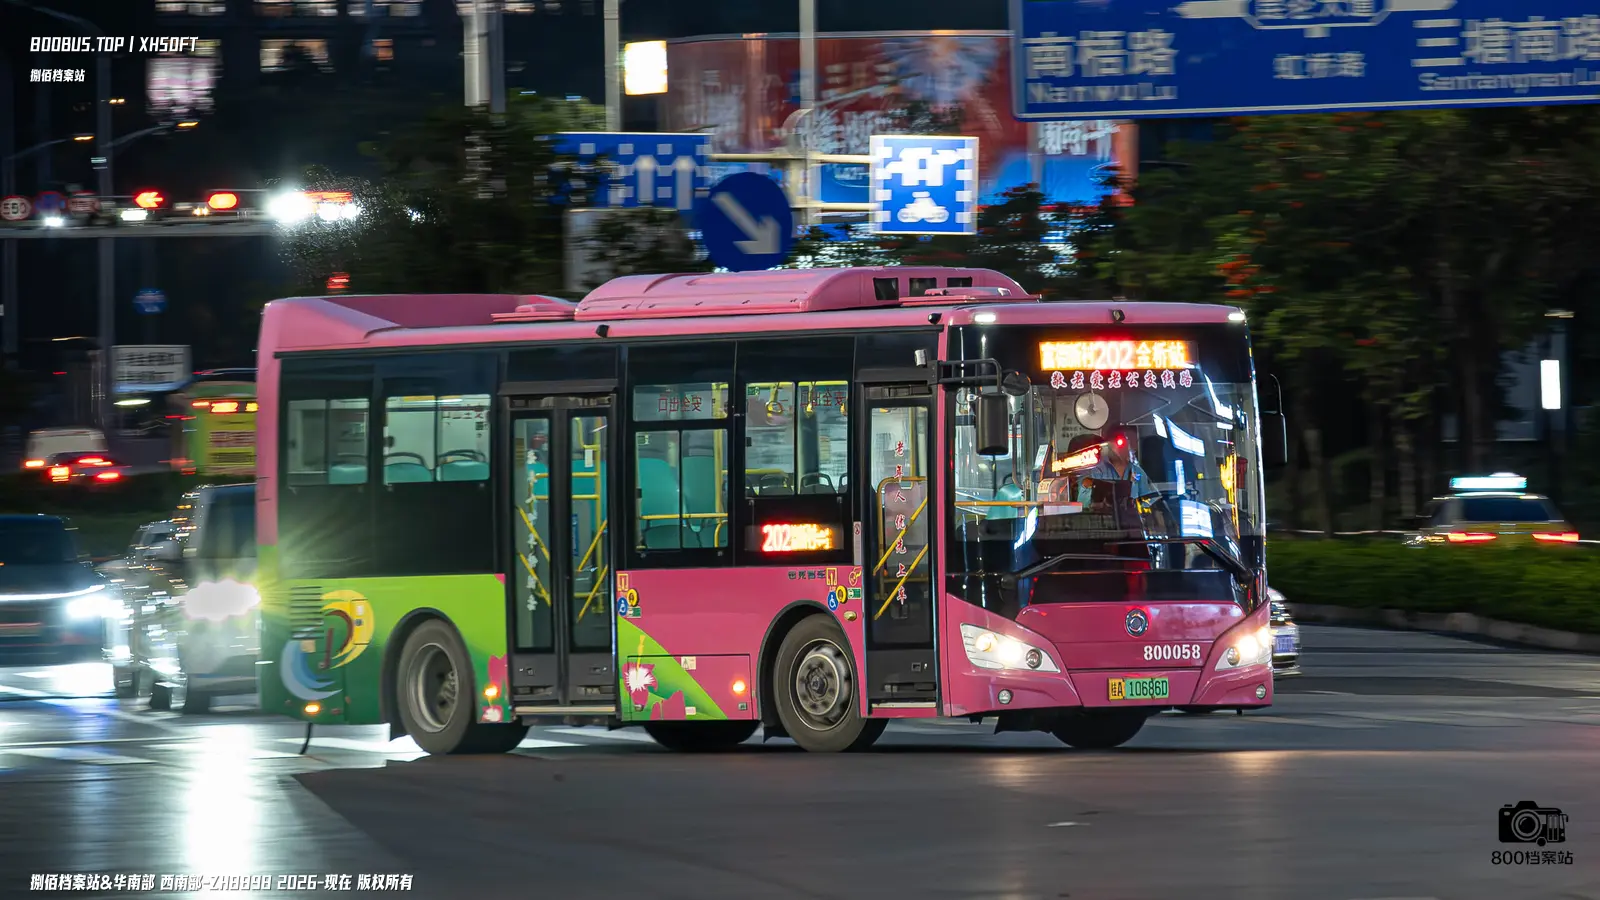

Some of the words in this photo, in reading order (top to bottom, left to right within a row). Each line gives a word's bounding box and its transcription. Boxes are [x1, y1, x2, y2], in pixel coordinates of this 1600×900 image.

[1094, 340, 1134, 369] 202
[762, 524, 792, 552] 202
[1143, 644, 1201, 661] 800058
[1129, 680, 1168, 697] 10686D
